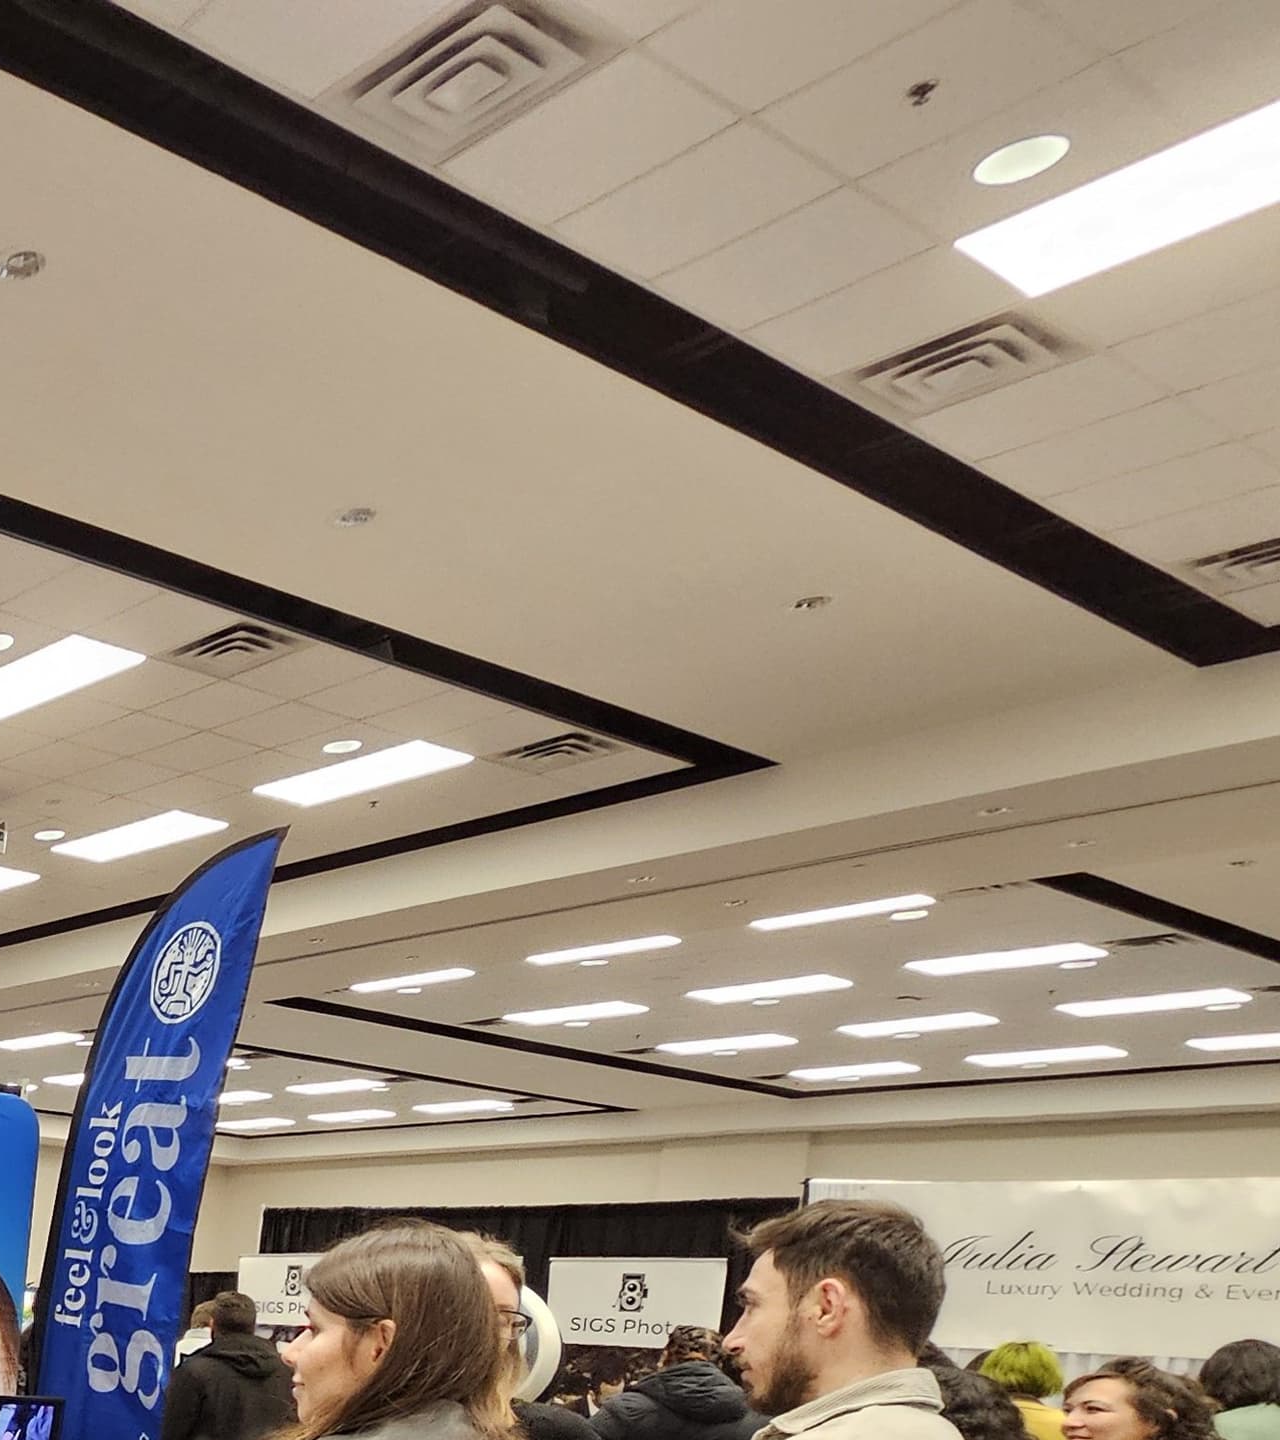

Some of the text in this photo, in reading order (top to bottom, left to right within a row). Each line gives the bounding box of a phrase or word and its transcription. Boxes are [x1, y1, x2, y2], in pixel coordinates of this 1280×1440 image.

[87, 1036, 201, 1411] great
[943, 1230, 1059, 1272] Julia
[986, 1280, 1062, 1298] Luxury
[1073, 1281, 1183, 1302] Wedding
[1194, 1284, 1214, 1299] &
[570, 1316, 616, 1333] SIGS
